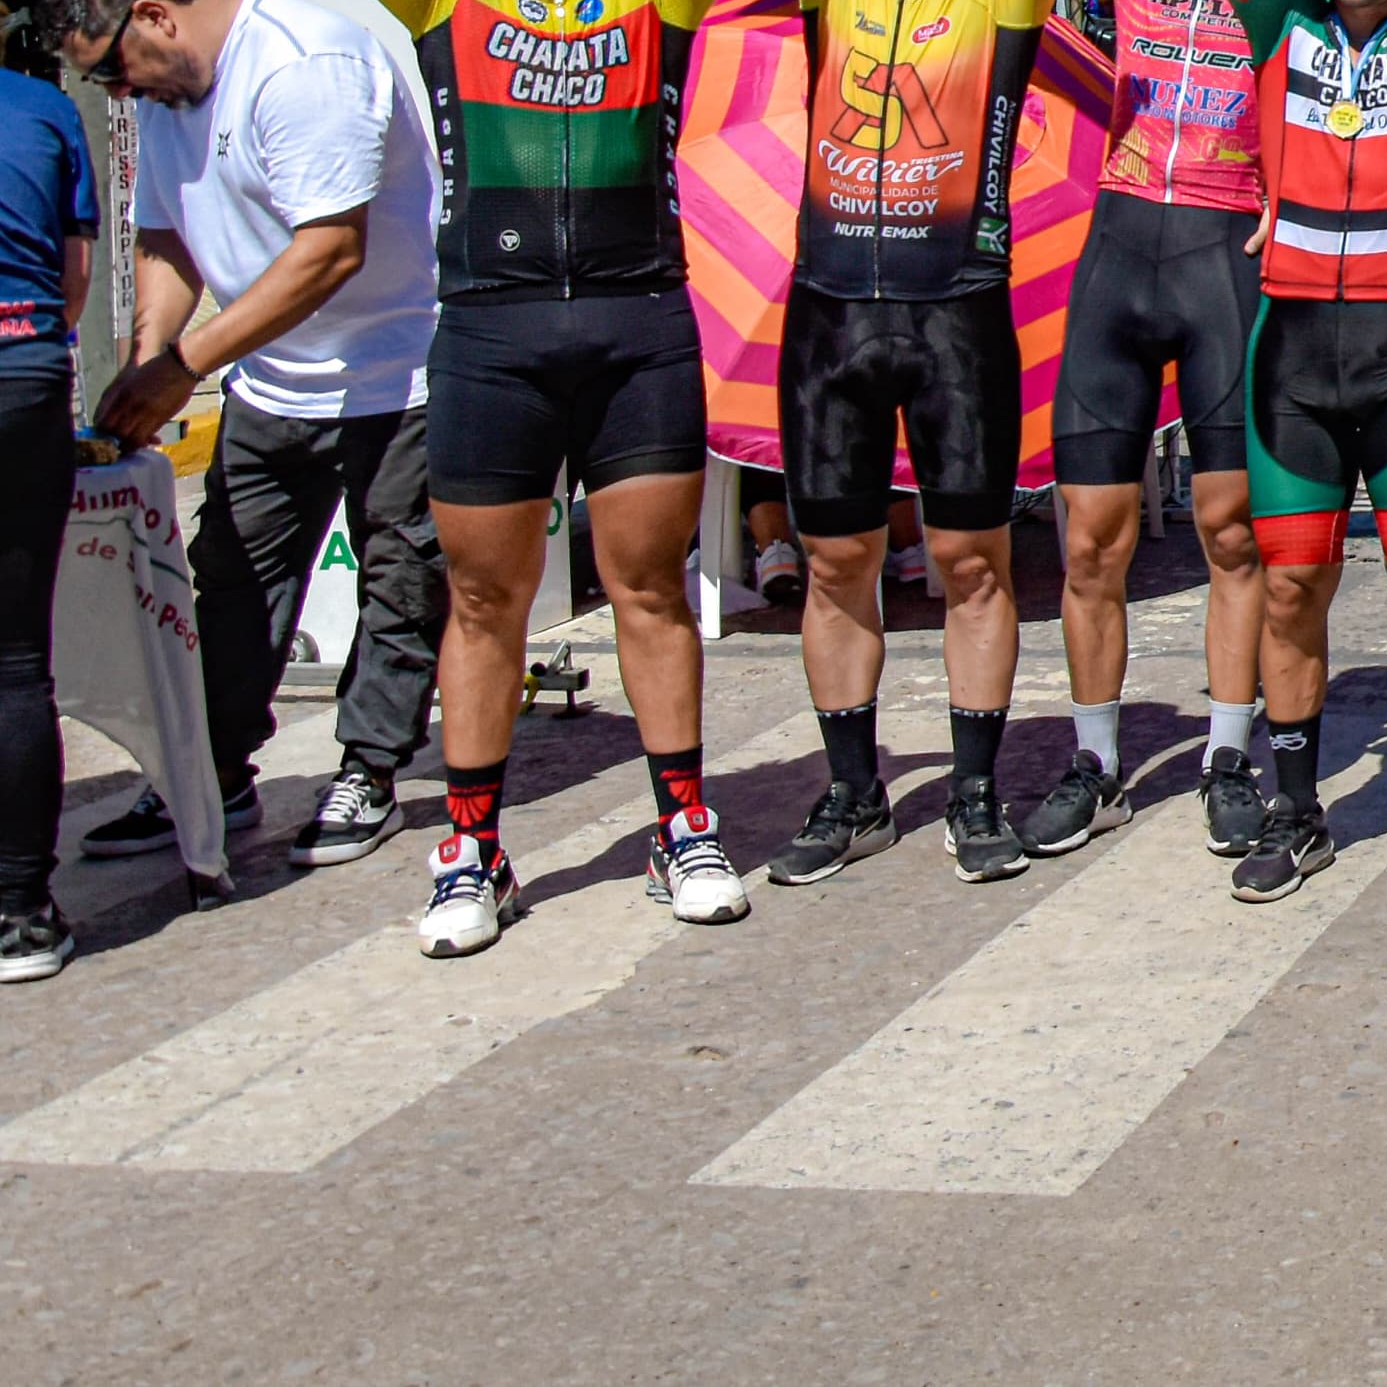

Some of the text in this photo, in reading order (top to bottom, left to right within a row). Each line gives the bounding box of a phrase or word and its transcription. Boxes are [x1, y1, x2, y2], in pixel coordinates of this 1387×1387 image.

[818, 139, 964, 183] Wilier
[984, 94, 1008, 214] CHIVILCOY
[829, 177, 939, 197] MUNICIPALIDAD DE
[829, 192, 939, 216] CHIVILCOY
